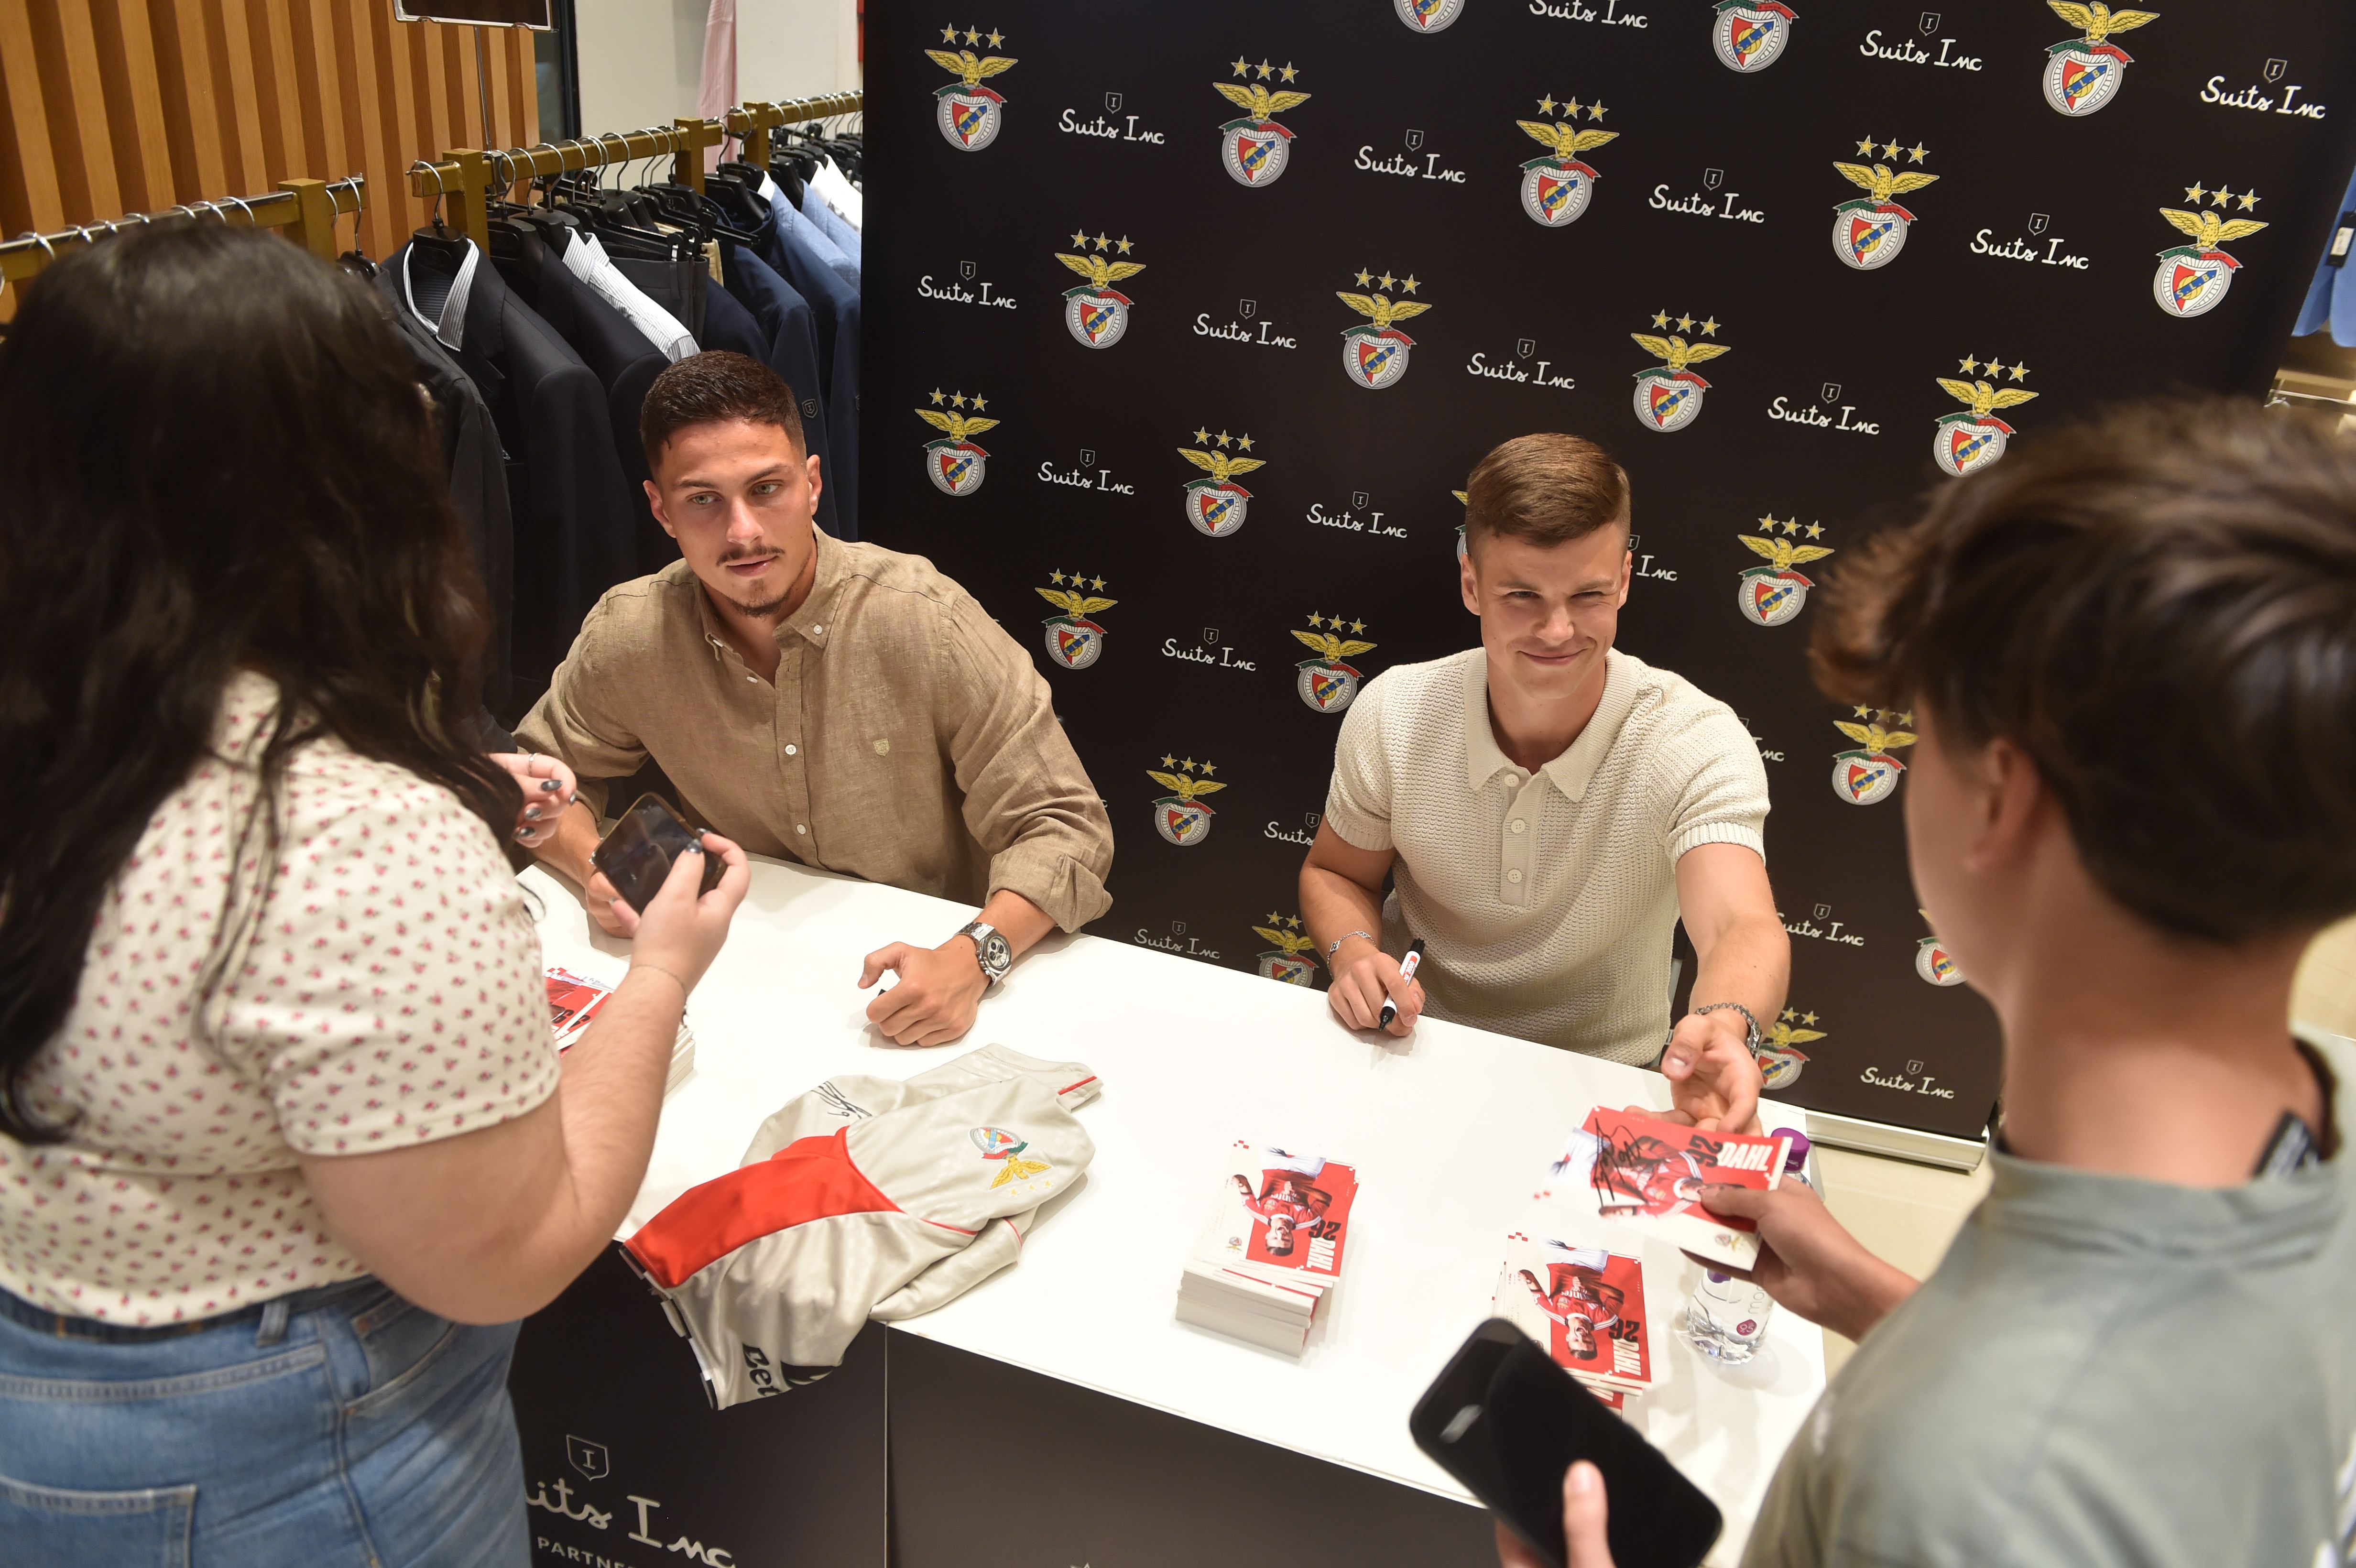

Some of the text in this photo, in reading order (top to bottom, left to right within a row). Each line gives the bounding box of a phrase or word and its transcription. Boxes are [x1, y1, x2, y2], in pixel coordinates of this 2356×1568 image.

[1529, 0, 1647, 28] Suits Inc
[1860, 30, 1982, 71] Suits Inc
[2201, 76, 2325, 119] Suits Inc
[1059, 109, 1164, 144] Suits Inc
[1354, 146, 1465, 183] Suits Inc
[1649, 185, 1764, 223] Suits Inc
[1970, 229, 2088, 269] Suits Inc
[918, 276, 1016, 309] Suits Inc
[1193, 314, 1296, 348] Suits Inc
[1467, 353, 1574, 389] Suits Inc
[1768, 397, 1879, 435] Suits Inc
[1038, 462, 1134, 495] Suits Inc
[1307, 504, 1407, 538] Suits Inc
[1636, 555, 1677, 581] Inc
[1162, 639, 1255, 671] Suits Inc
[1264, 821, 1314, 846] Suits
[1134, 929, 1220, 959] Suits Inc
[1826, 923, 1864, 946] Inc
[1861, 1067, 1953, 1099] Suits Inc
[1686, 1134, 1723, 1168] 26
[1717, 1142, 1773, 1172] DAHL
[1308, 1220, 1342, 1241] 26
[1306, 1237, 1336, 1271] DAHL
[1609, 1318, 1640, 1342] 26
[1613, 1338, 1642, 1376] DAHL
[526, 1478, 736, 1568] its Inc
[537, 1536, 637, 1568] PARTNE
